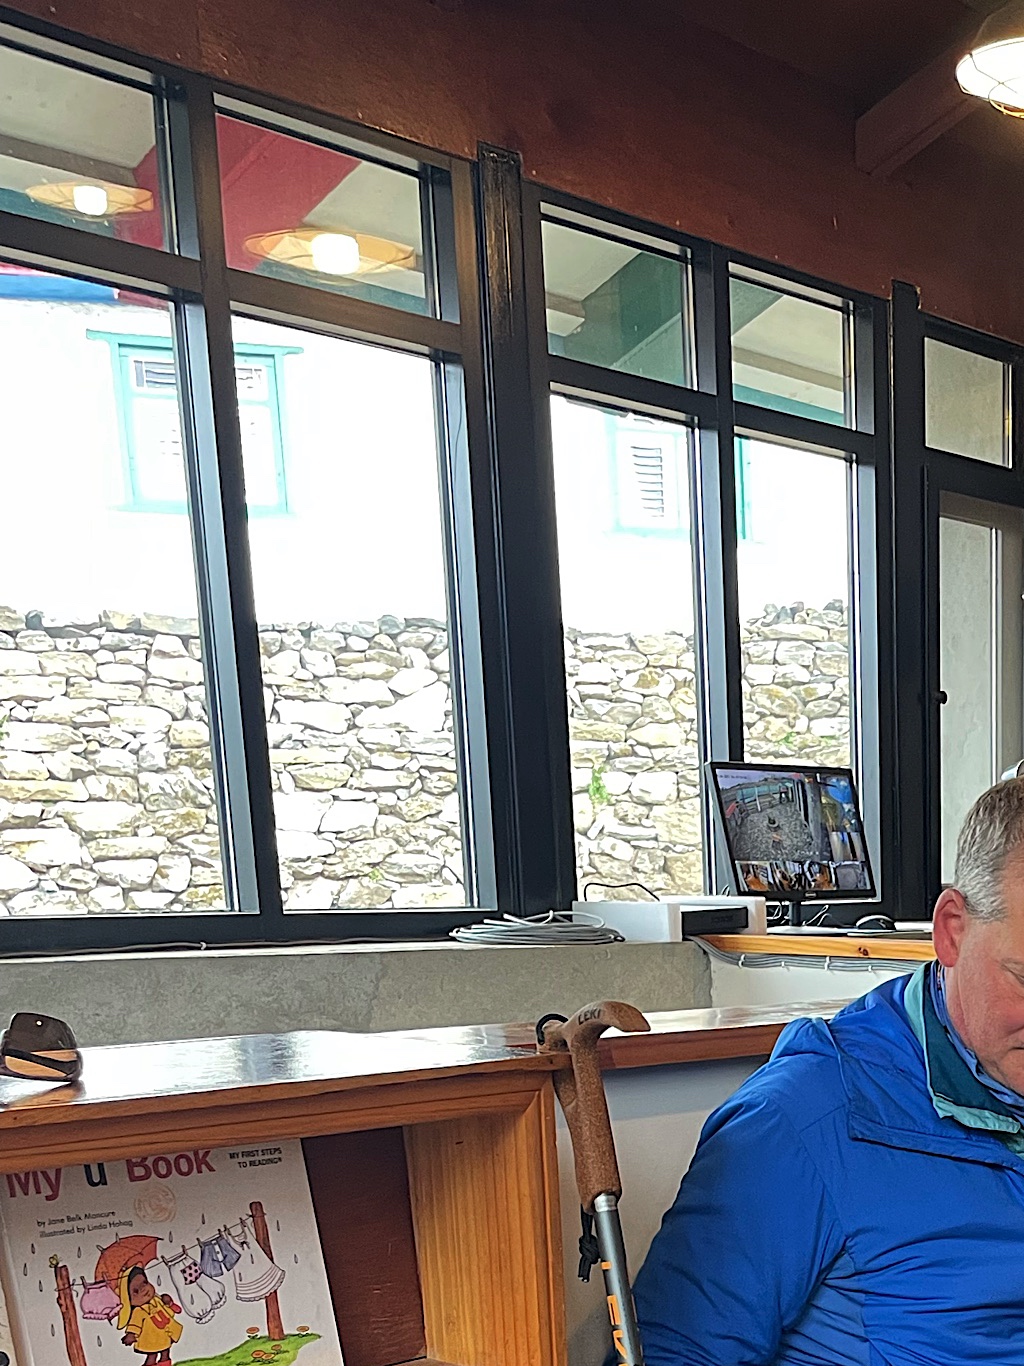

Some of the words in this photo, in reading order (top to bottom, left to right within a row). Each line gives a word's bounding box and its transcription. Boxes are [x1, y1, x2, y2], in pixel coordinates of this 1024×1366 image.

[578, 1007, 602, 1026] LEKI
[229, 1151, 240, 1160] MY
[241, 1149, 259, 1158] FIRST
[261, 1147, 282, 1156] STEPS
[237, 1161, 248, 1169] TO
[6, 1168, 62, 1201] My
[126, 1150, 216, 1183] Book
[36, 1219, 46, 1228] by
[77, 1225, 86, 1234] by
[87, 1222, 108, 1232] Linda
